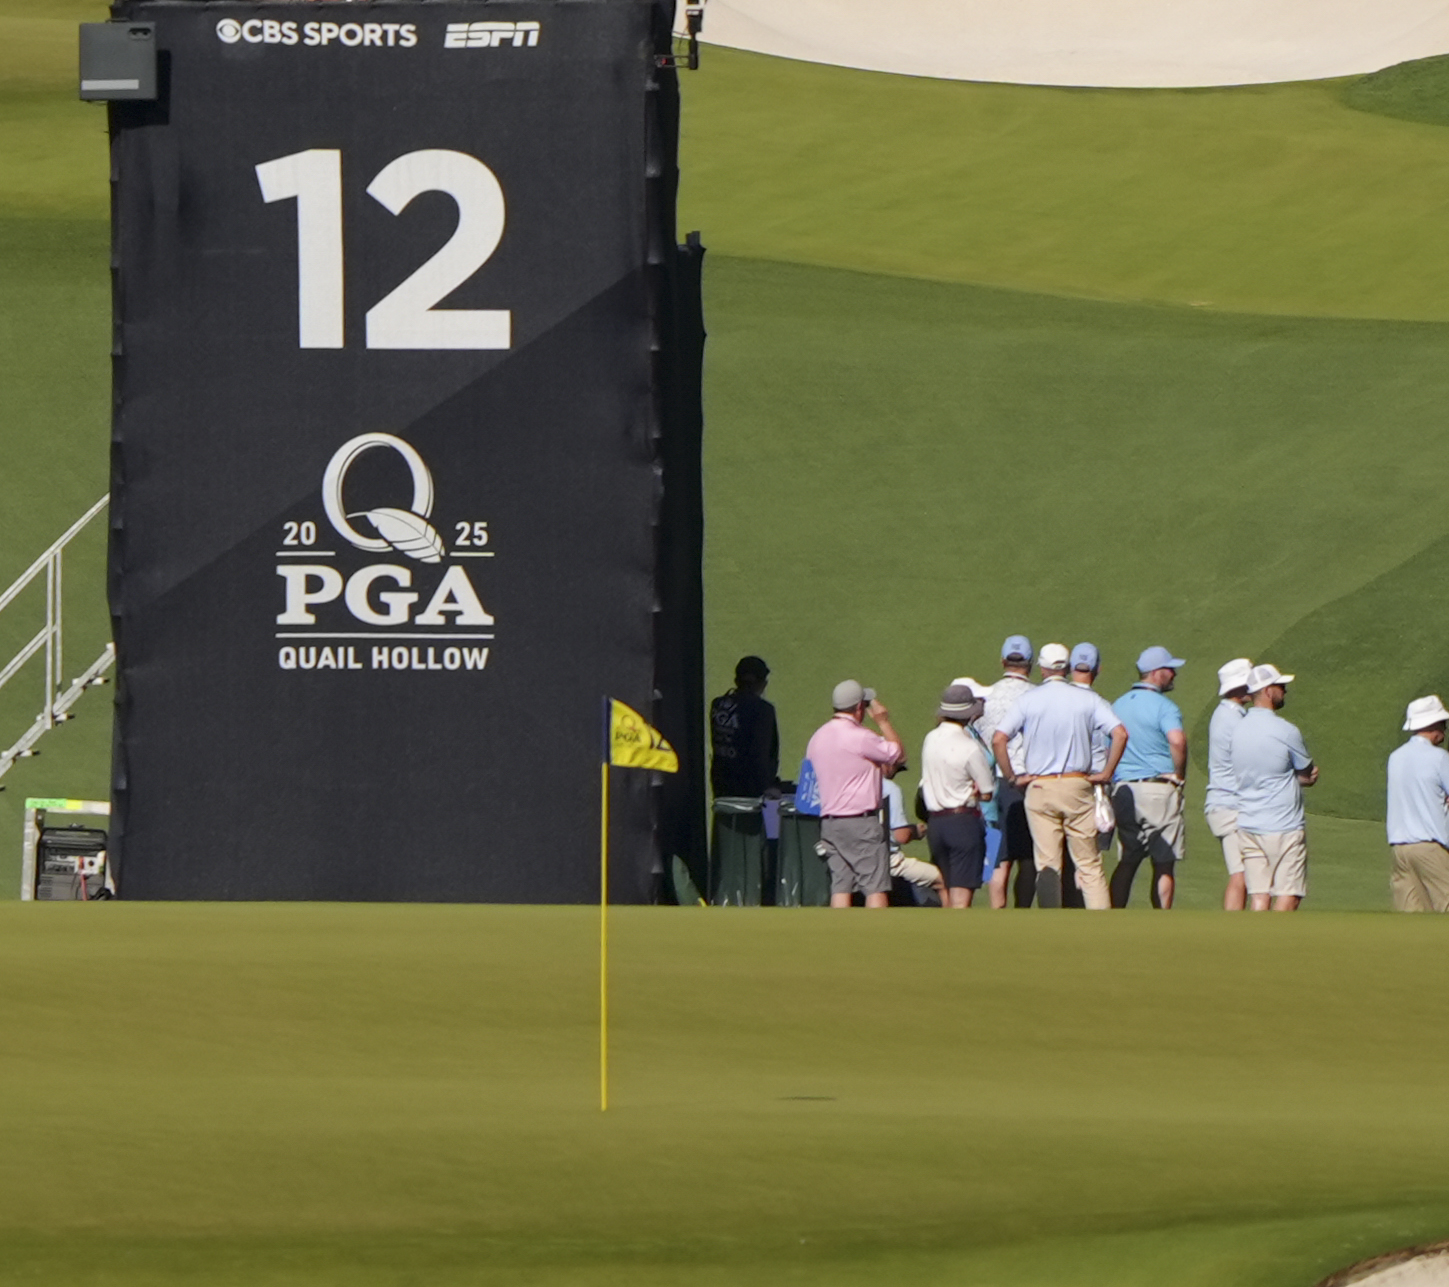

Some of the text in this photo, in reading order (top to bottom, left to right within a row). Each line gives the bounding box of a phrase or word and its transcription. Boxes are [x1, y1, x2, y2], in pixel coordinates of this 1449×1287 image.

[241, 18, 540, 48] CBS SPORTS ESPN
[255, 148, 511, 350] 12
[283, 521, 489, 546] 20 25
[276, 564, 494, 625] PGA
[278, 646, 489, 670] QUAIL HOLLOW
